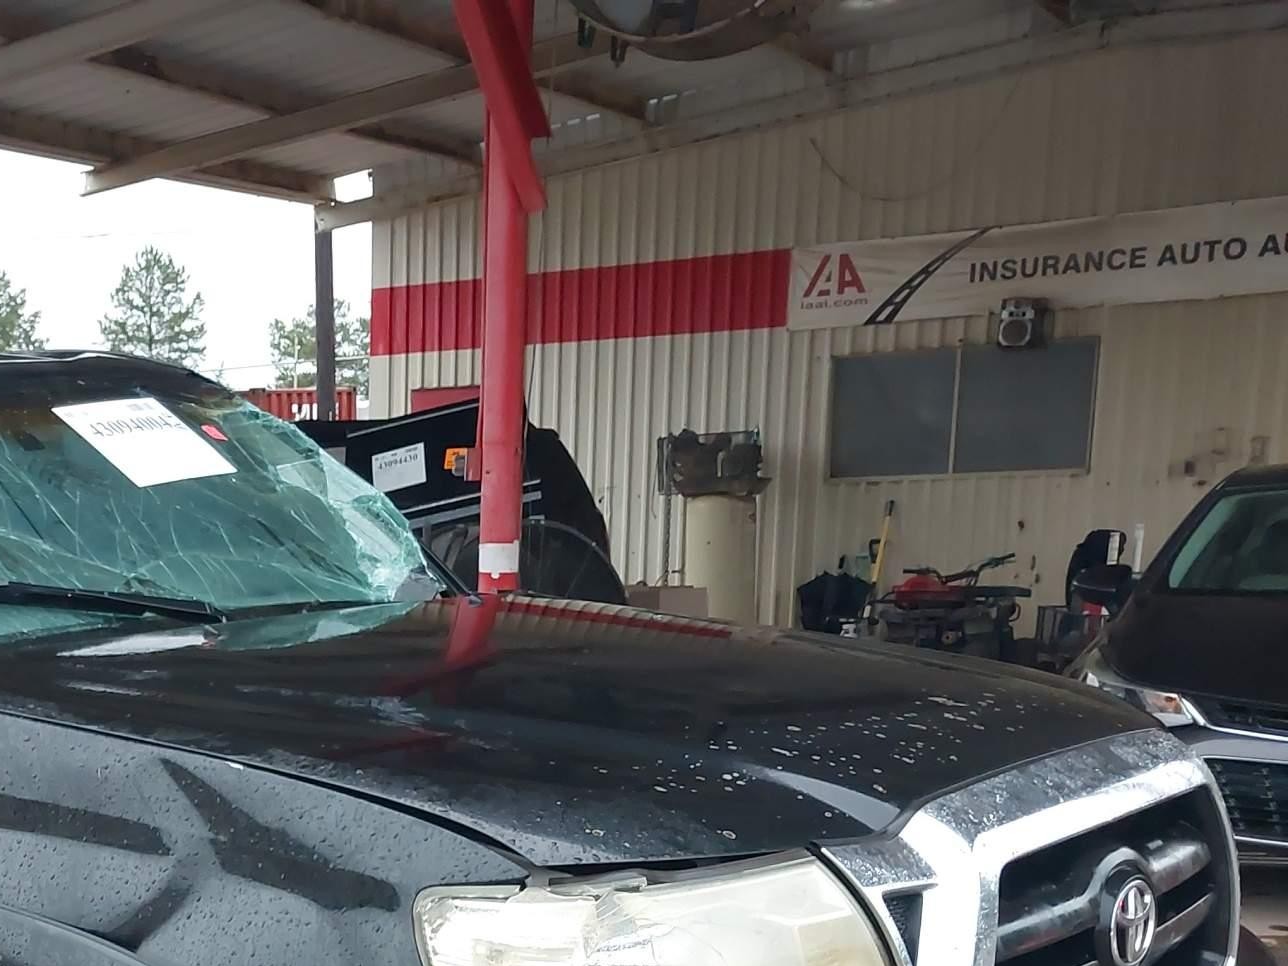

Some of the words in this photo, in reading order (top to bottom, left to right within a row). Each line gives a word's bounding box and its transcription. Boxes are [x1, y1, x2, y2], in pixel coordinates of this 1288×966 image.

[969, 246, 1148, 283] INSURANCE
[1157, 237, 1247, 267] AUTO
[1258, 232, 1288, 257] A
